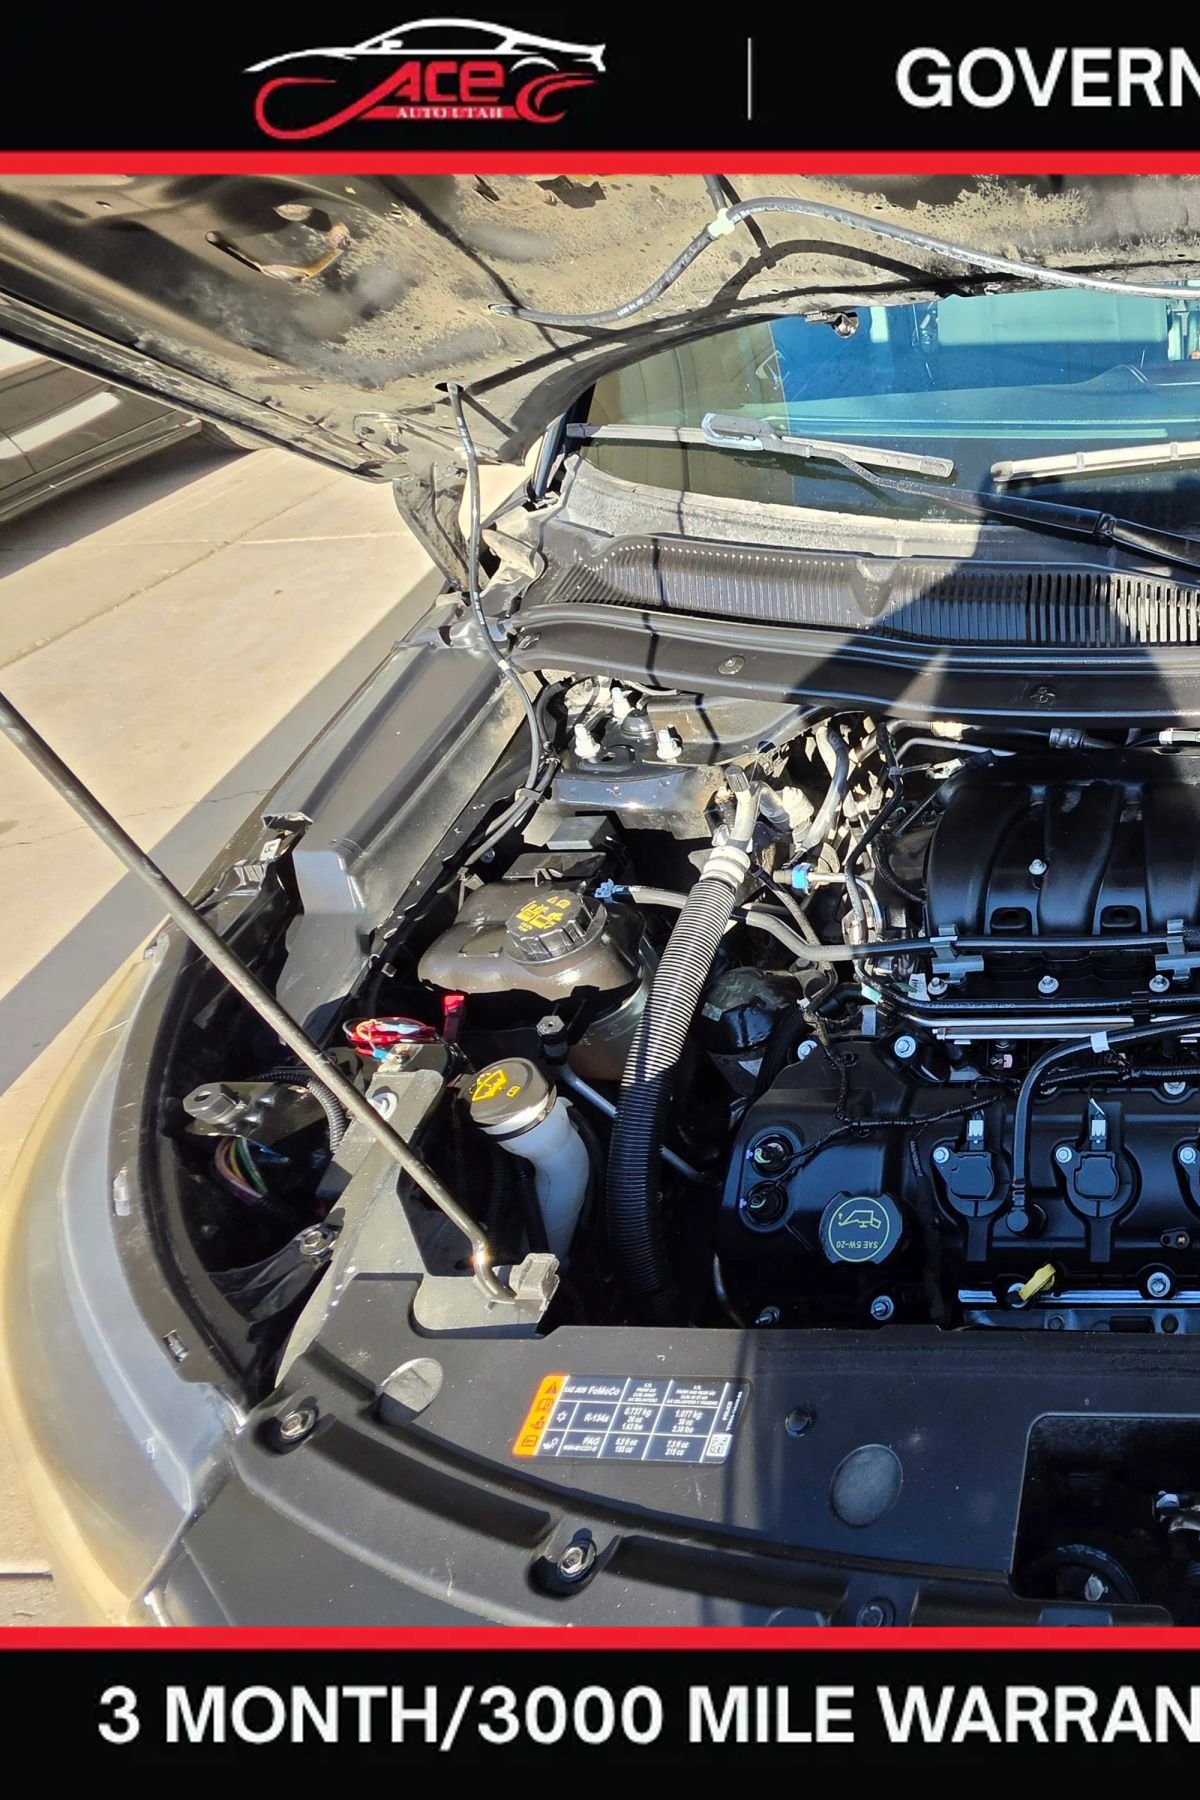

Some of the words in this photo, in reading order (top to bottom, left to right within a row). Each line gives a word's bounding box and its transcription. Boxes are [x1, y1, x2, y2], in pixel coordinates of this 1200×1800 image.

[835, 1240, 862, 1249] 5W-20
[862, 1240, 879, 1249] SAE
[588, 1385, 621, 1396] FoMoCo
[583, 1412, 610, 1423] R-134a
[642, 1409, 652, 1418] kg
[675, 1409, 692, 1418] 1.077
[692, 1411, 703, 1420] kg
[582, 1436, 601, 1446] PAG
